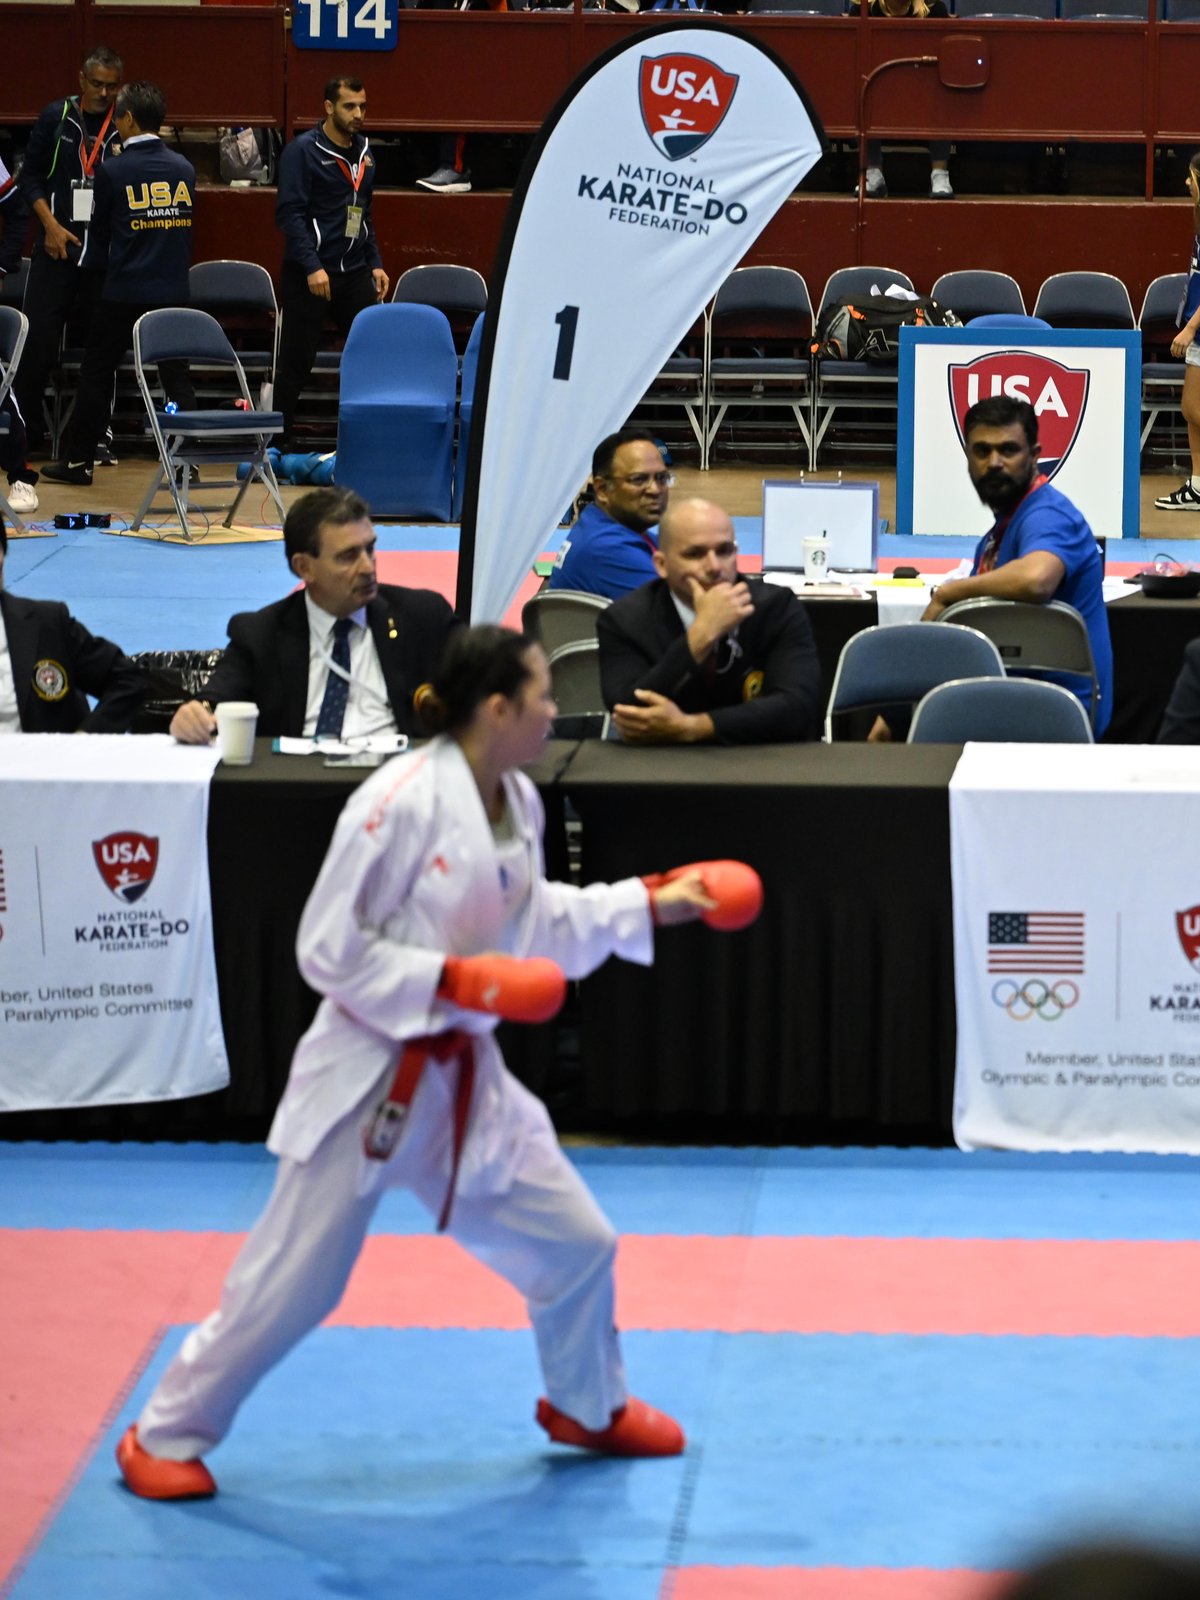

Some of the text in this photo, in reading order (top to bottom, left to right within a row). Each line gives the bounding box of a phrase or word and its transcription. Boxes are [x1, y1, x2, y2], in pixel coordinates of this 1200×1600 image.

[297, 0, 392, 39] 114
[650, 64, 719, 106] USA
[617, 163, 717, 195] NATIONAL
[126, 181, 192, 210] USA
[577, 175, 748, 225] KARATE-DO
[130, 217, 192, 230] Champions
[147, 208, 180, 218] KARATE
[609, 207, 710, 236] FEDERATION
[552, 304, 580, 382] 1
[967, 373, 1069, 418] USA
[101, 841, 151, 865] USA
[97, 909, 166, 923] NATIONAL
[75, 918, 189, 943] KARATE-DO
[99, 939, 168, 952] FEDERATION
[38, 984, 94, 1001] United
[99, 982, 154, 999] States
[5, 1004, 100, 1025] Paralympic
[1106, 1052, 1165, 1068] United
